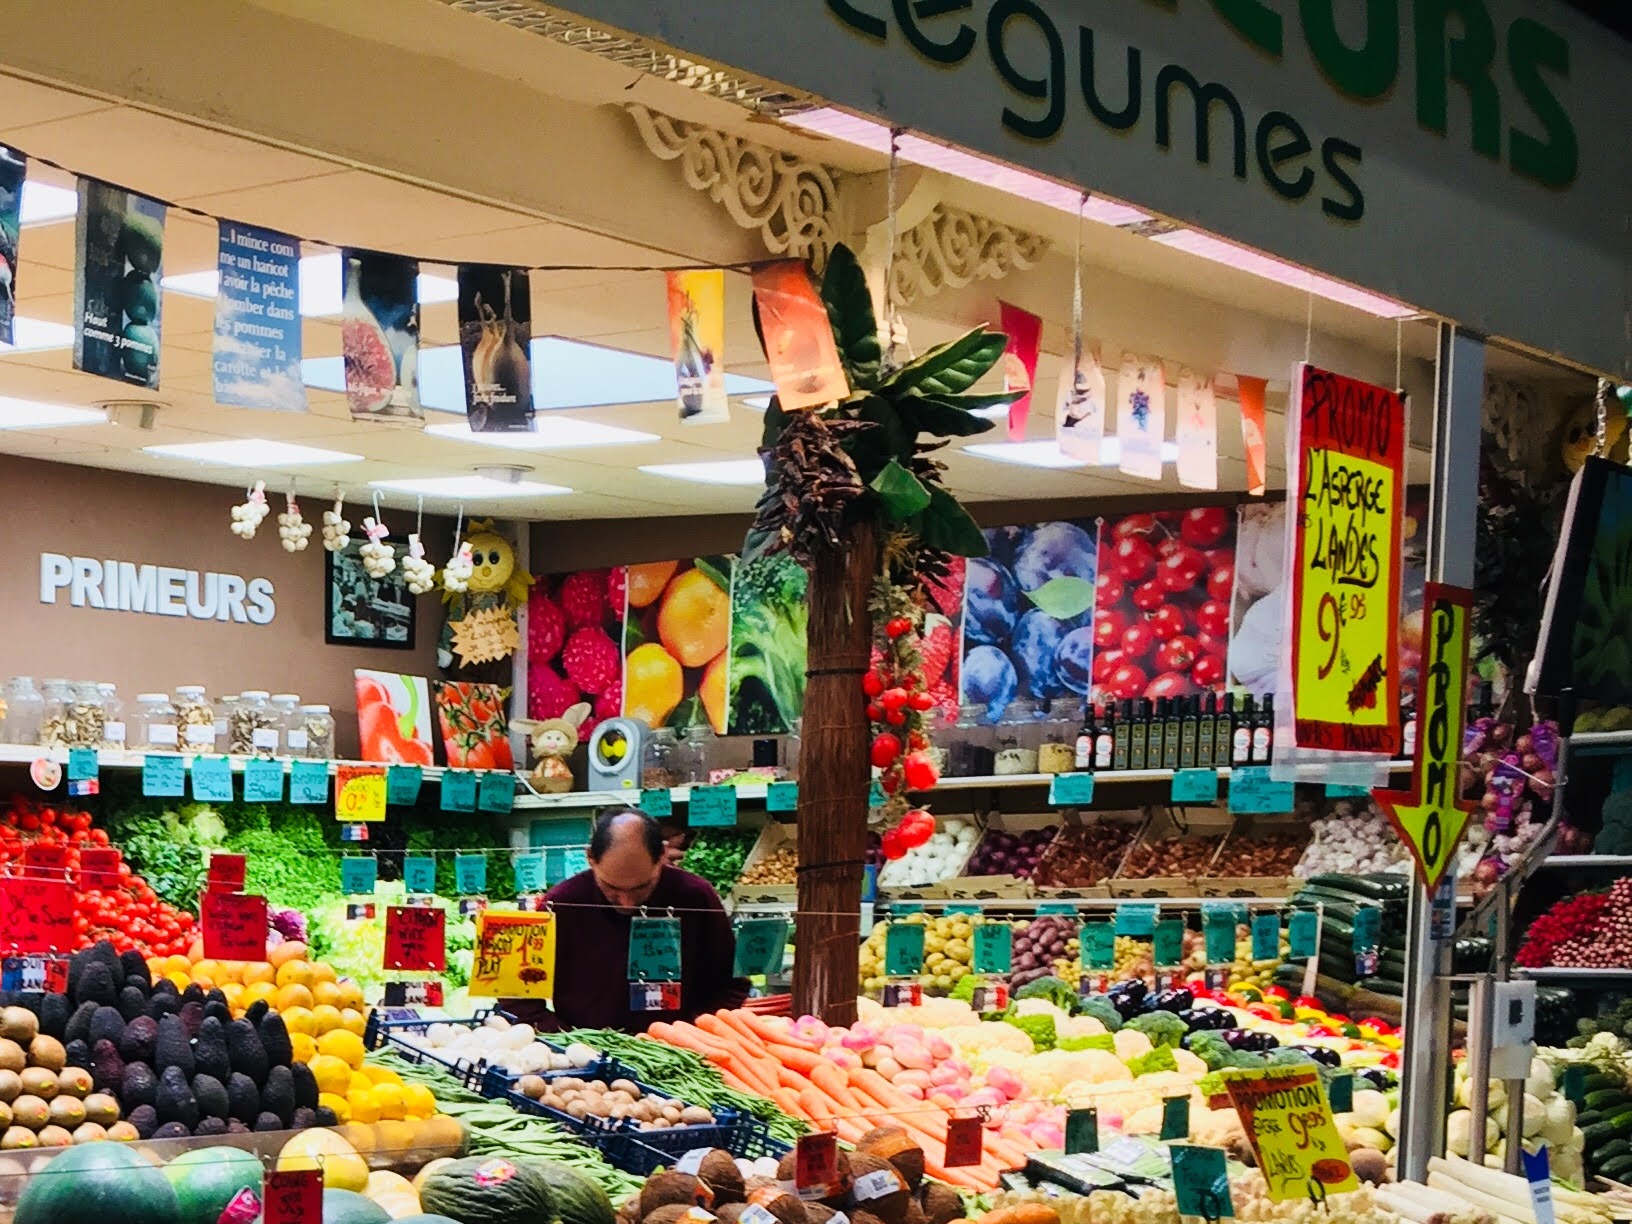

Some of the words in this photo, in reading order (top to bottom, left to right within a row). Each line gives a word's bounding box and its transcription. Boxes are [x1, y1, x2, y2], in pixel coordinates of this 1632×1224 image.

[237, 232, 269, 252] mince
[219, 251, 237, 266] me
[237, 256, 252, 270] un
[253, 255, 289, 278] haricot
[267, 301, 295, 321] dans
[233, 319, 285, 340] pommes
[39, 551, 276, 625] PRIMEURS
[1423, 598, 1455, 868] PROMO
